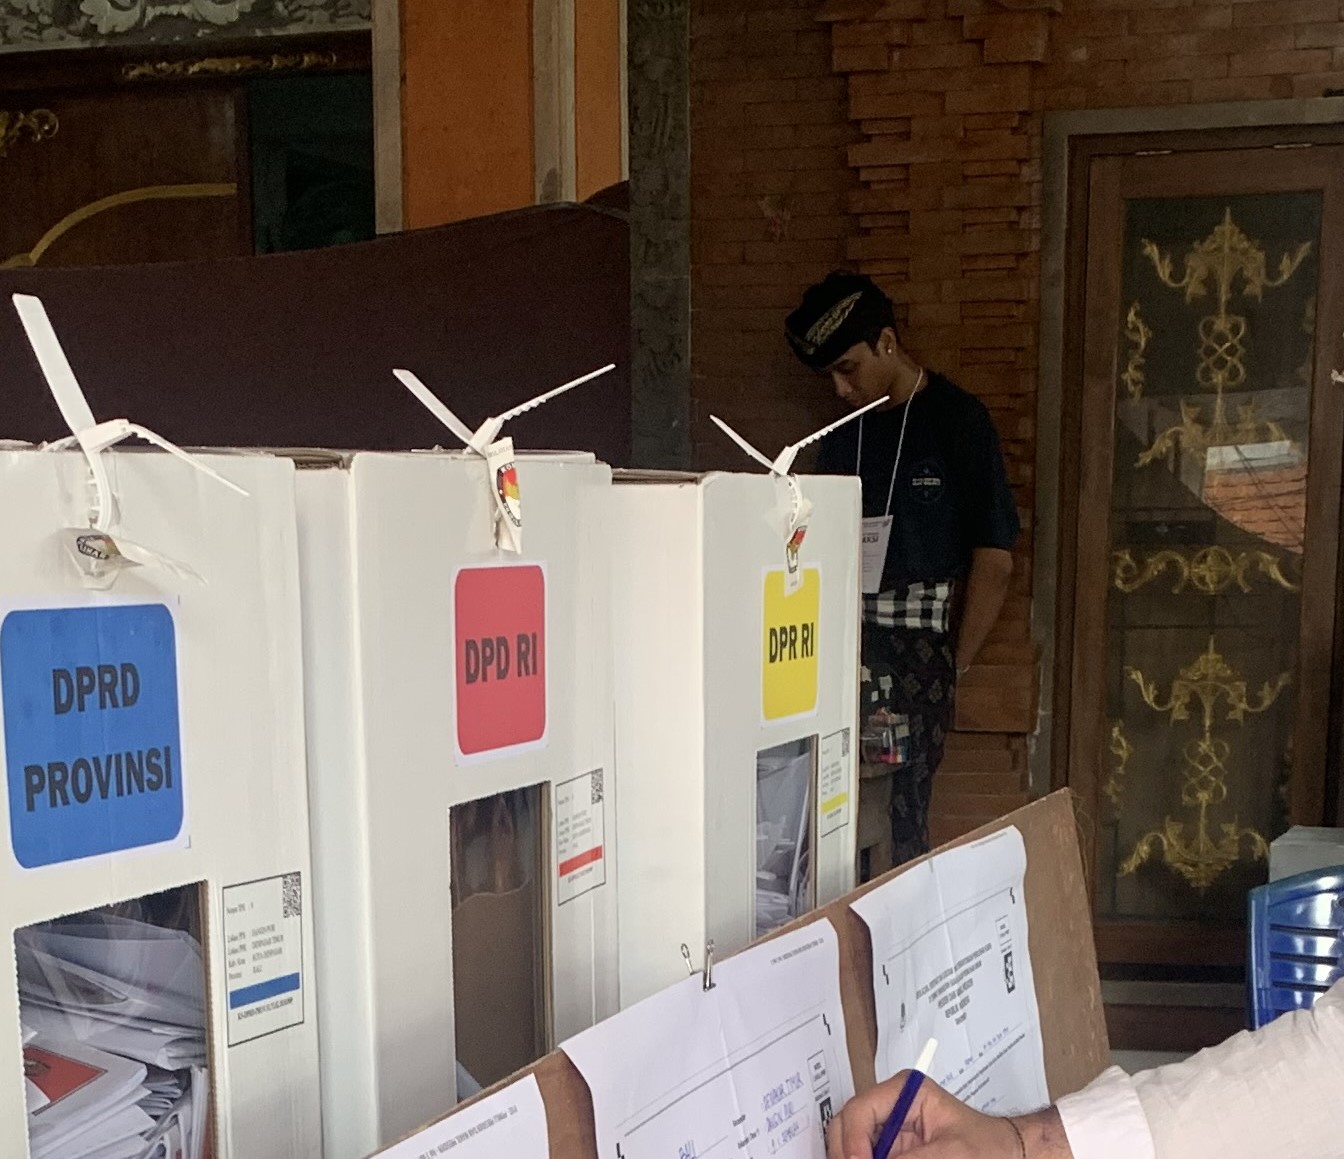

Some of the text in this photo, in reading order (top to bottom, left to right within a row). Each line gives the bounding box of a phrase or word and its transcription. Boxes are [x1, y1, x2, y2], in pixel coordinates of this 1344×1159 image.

[465, 632, 537, 684] DPD RI
[769, 622, 814, 664] DPR RI
[52, 663, 139, 715] DPRD
[24, 746, 172, 812] PROVINSI
